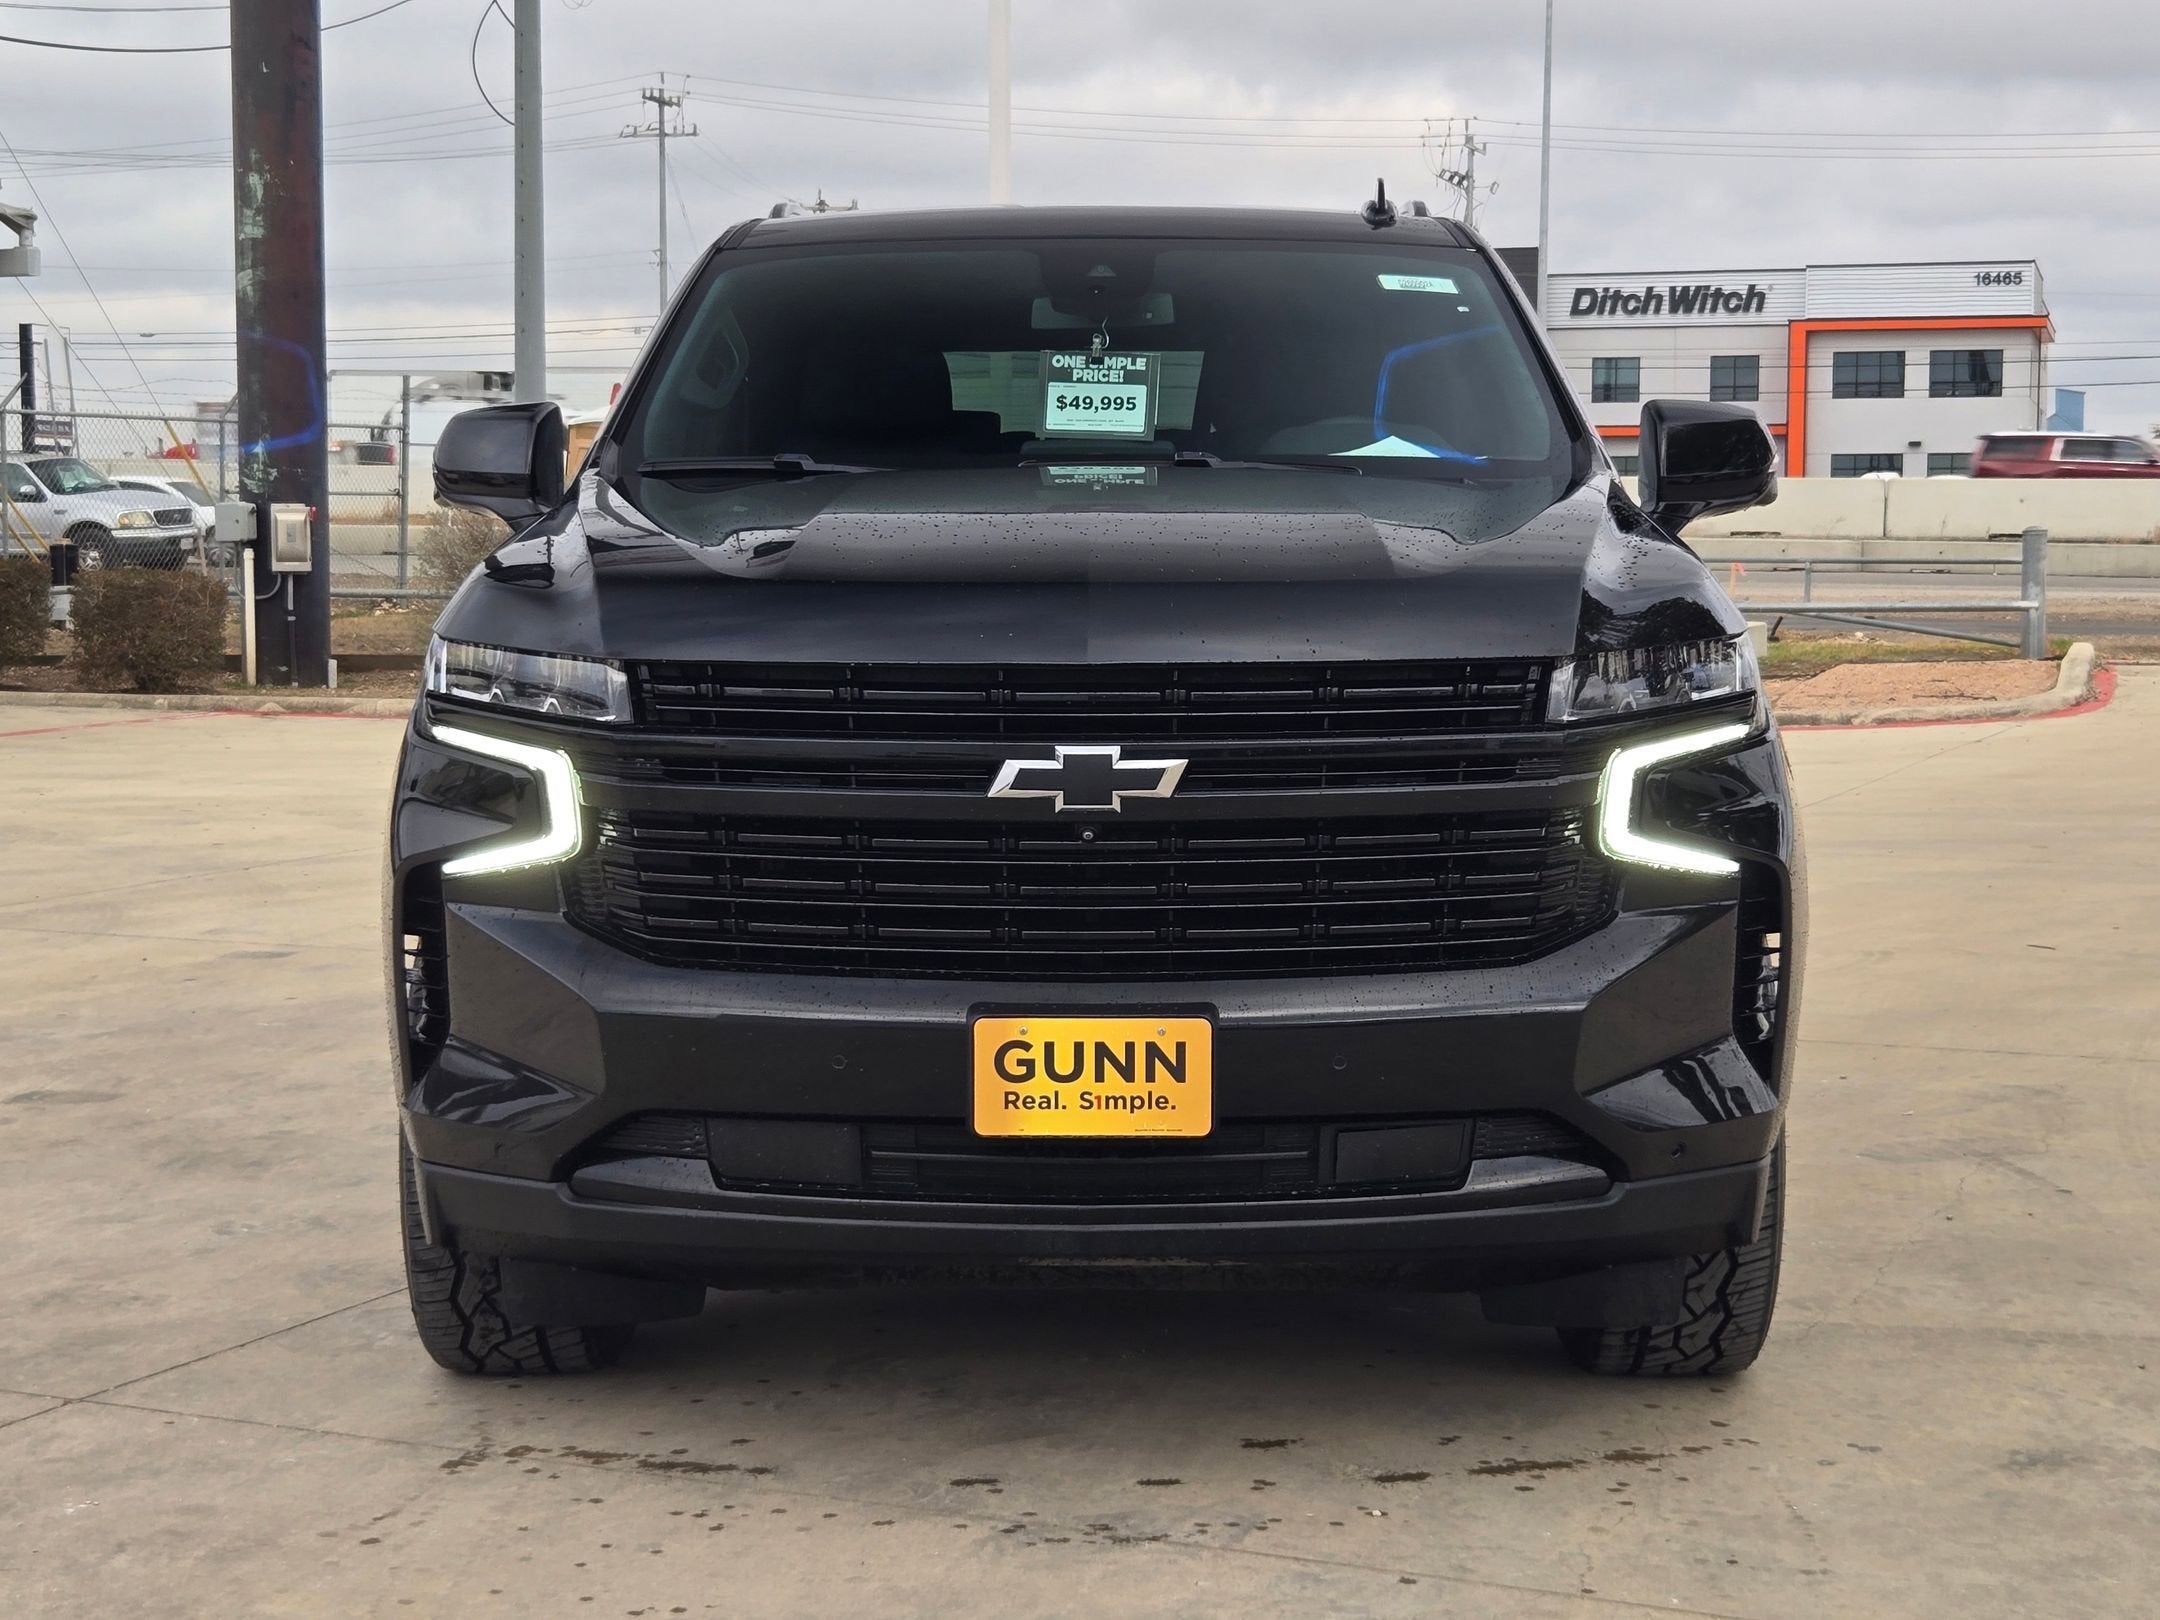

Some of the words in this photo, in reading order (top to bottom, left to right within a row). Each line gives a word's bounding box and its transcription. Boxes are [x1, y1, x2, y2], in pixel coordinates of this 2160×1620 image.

[1973, 271, 2022, 286] 16465
[1570, 286, 1664, 316] Ditch
[1667, 284, 1767, 314] Witch
[1052, 355, 1086, 368] ONE
[1089, 356, 1147, 370] MPLE
[1072, 369, 1124, 383] PRICE!
[1056, 394, 1137, 414] $49,995
[994, 1039, 1187, 1084] GUNN
[1004, 1090, 1067, 1110] Real.
